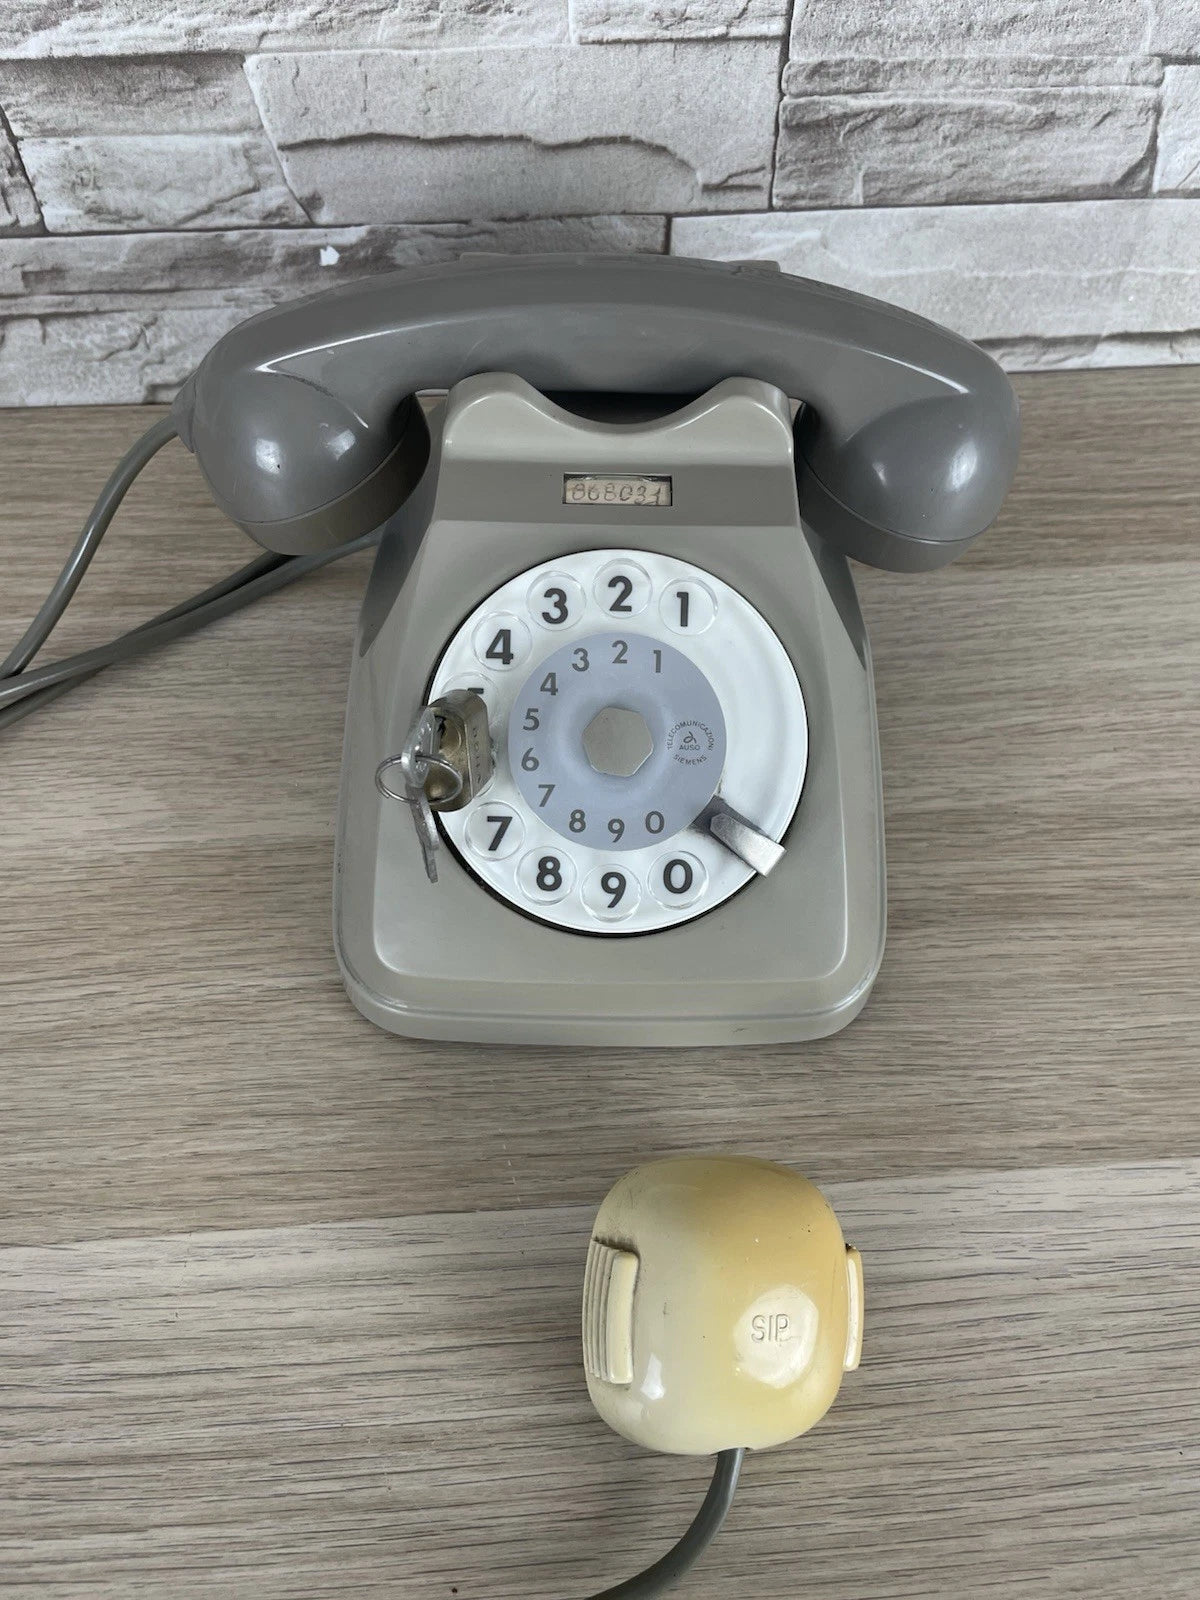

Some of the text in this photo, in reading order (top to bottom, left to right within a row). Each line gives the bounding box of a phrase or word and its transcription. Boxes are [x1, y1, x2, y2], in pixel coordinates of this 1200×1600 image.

[542, 588, 568, 624] 3
[608, 576, 632, 612] 2
[676, 592, 689, 627] 1
[486, 629, 514, 665] 4
[612, 640, 629, 664] 2
[571, 648, 590, 672] 3
[653, 650, 662, 673] 1
[540, 672, 559, 696] 4
[522, 708, 540, 731] 5
[521, 748, 540, 771] 6
[673, 754, 708, 766] SIEMENS
[538, 784, 556, 807] 7
[569, 809, 587, 833] 8
[607, 818, 626, 843] 9
[645, 811, 665, 834] 0
[487, 816, 513, 851] 7
[536, 856, 562, 891] 8
[663, 859, 693, 894] 0
[601, 872, 627, 908] 9
[751, 1313, 790, 1342] SIP
